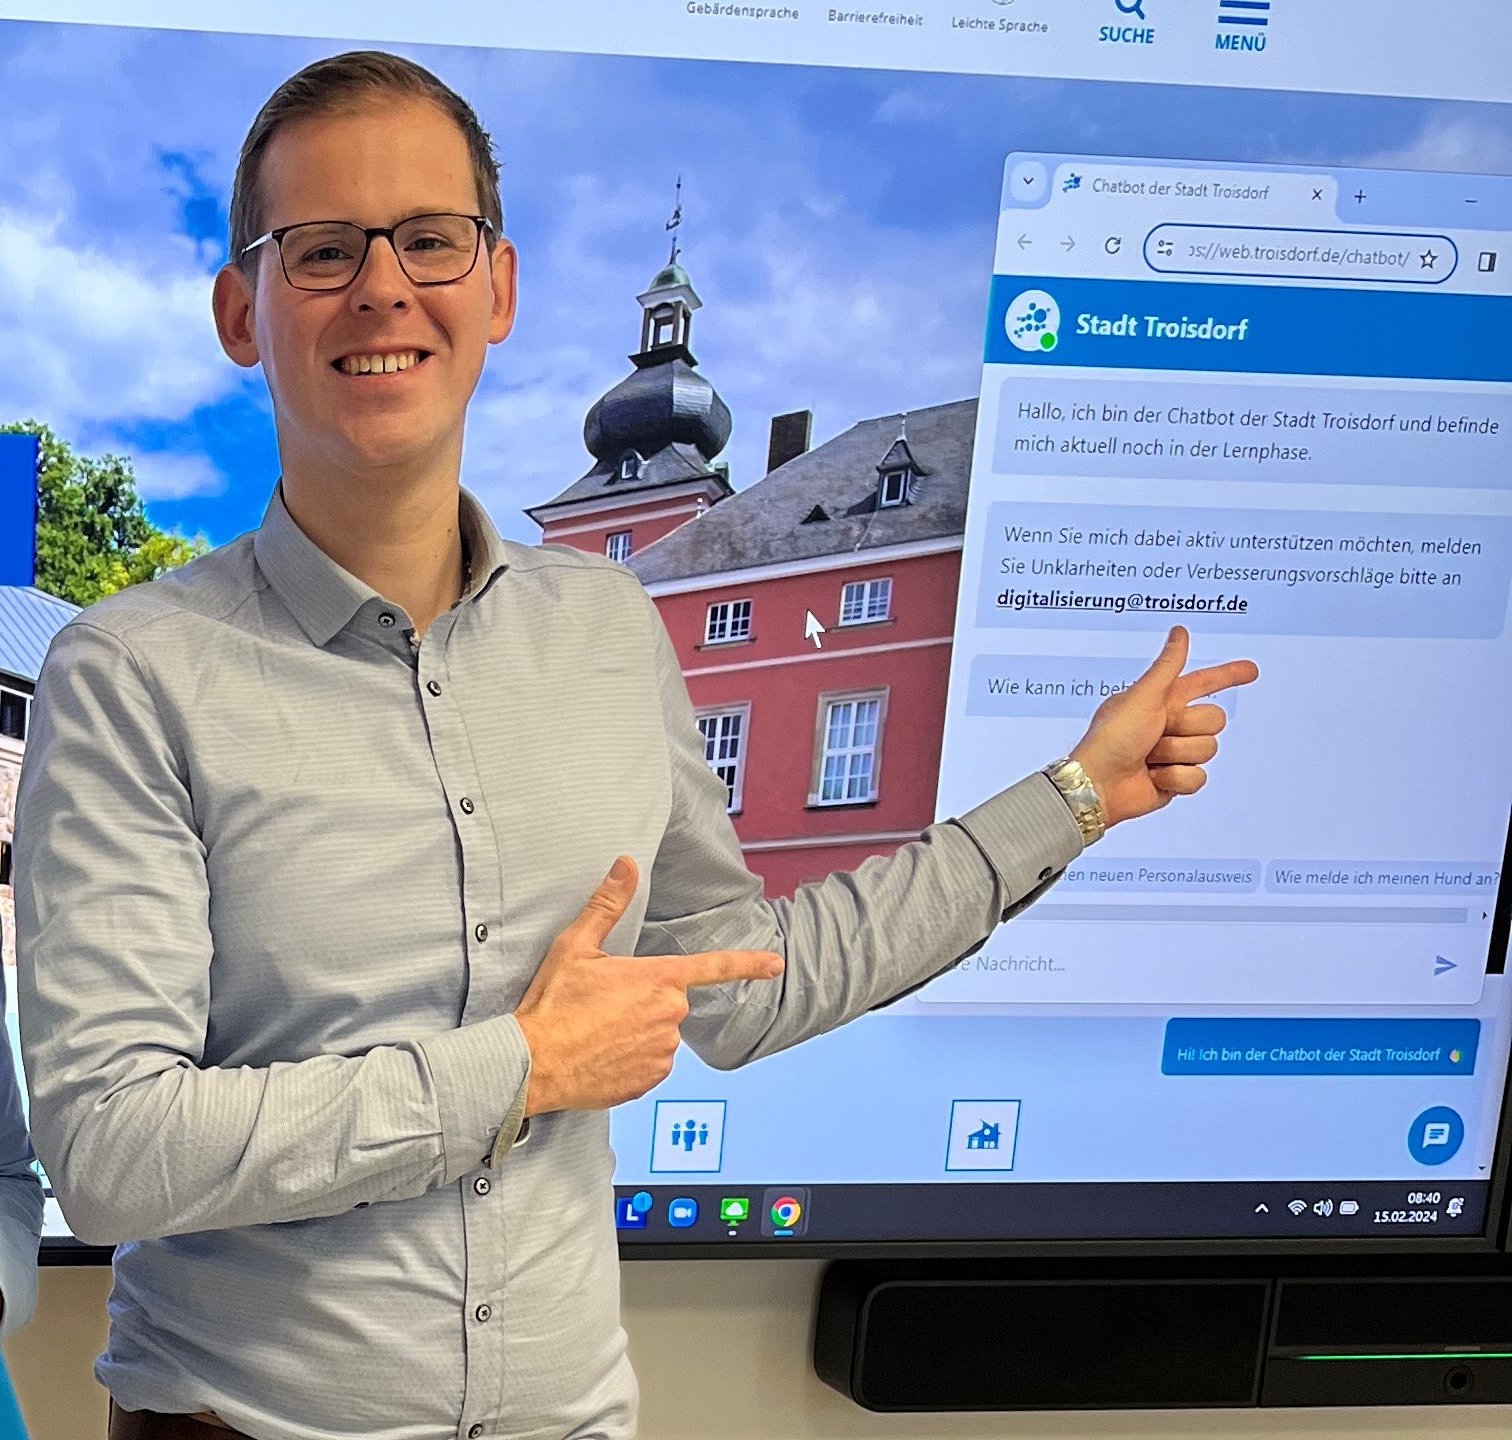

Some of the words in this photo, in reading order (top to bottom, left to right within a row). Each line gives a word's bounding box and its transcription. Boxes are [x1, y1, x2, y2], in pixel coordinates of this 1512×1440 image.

[686, 1, 799, 20] Gebärdensprache
[828, 8, 924, 27] Barrierefreiheit
[951, 16, 996, 31] Leichte
[998, 18, 1049, 34] Sprache
[1098, 25, 1155, 45] SUCHE
[1215, 32, 1267, 52] MENÜ
[1092, 177, 1145, 195] Chatbot
[1148, 180, 1172, 196] der
[1174, 181, 1209, 198] Stadt
[1212, 183, 1271, 200] Troisdorf
[1075, 313, 1138, 337] Stadt
[1143, 315, 1249, 341] Troisdorf
[1018, 401, 1066, 422] Hallo,
[1071, 402, 1096, 421] ich
[1101, 403, 1128, 422] bin
[1133, 405, 1163, 424] der
[1167, 406, 1236, 426] Chatbot
[1239, 408, 1269, 427] der
[1272, 410, 1317, 429] Stadt
[1322, 412, 1397, 431] Troisdorf
[1399, 414, 1433, 433] und
[1436, 415, 1500, 435] befinde
[1013, 433, 1055, 453] mich
[1060, 435, 1118, 455] aktuell
[1122, 438, 1164, 456] noch
[1169, 438, 1185, 457] in
[1189, 439, 1219, 458] der
[1223, 441, 1312, 464] Lernphase.
[1004, 525, 1053, 543] Wenn
[1058, 526, 1083, 545] Sie
[1088, 527, 1128, 546] mich
[1134, 528, 1182, 547] dabei
[1185, 530, 1226, 548] aktiv
[1229, 534, 1334, 551] unterstützen
[1339, 535, 1415, 556] möchten,
[1420, 537, 1482, 556] melden
[1000, 557, 1026, 575] Sie
[1031, 558, 1137, 578] Unklarheiten
[1142, 561, 1183, 579] oder
[1186, 562, 1395, 588] Verbesserungsvorschläge
[1399, 567, 1438, 585] bitte
[1442, 573, 1462, 586] an
[995, 588, 1248, 615] digitalisierung@troisdorf.de
[987, 677, 1020, 695] Wie
[1025, 677, 1065, 696] kann
[1070, 678, 1094, 697] ich
[1089, 871, 1134, 882] neuen
[1138, 867, 1253, 887] Personalausweis
[1275, 869, 1303, 884] Wie
[1305, 870, 1350, 885] melde
[1353, 870, 1374, 885] ich
[1377, 871, 1430, 886] meinen
[1433, 871, 1473, 886] Hund
[1474, 871, 1501, 886] an?
[1177, 1047, 1196, 1061] Hi!
[1198, 1047, 1219, 1062] Ich
[1221, 1047, 1242, 1061] bin
[1244, 1047, 1268, 1061] der
[1269, 1047, 1322, 1062] Chatbot
[1323, 1047, 1347, 1062] der
[1348, 1047, 1383, 1062] Stadt
[1385, 1047, 1442, 1062] Troisdorf
[1408, 1192, 1440, 1203] 08:40
[1374, 1211, 1437, 1222] 15.02.2024
